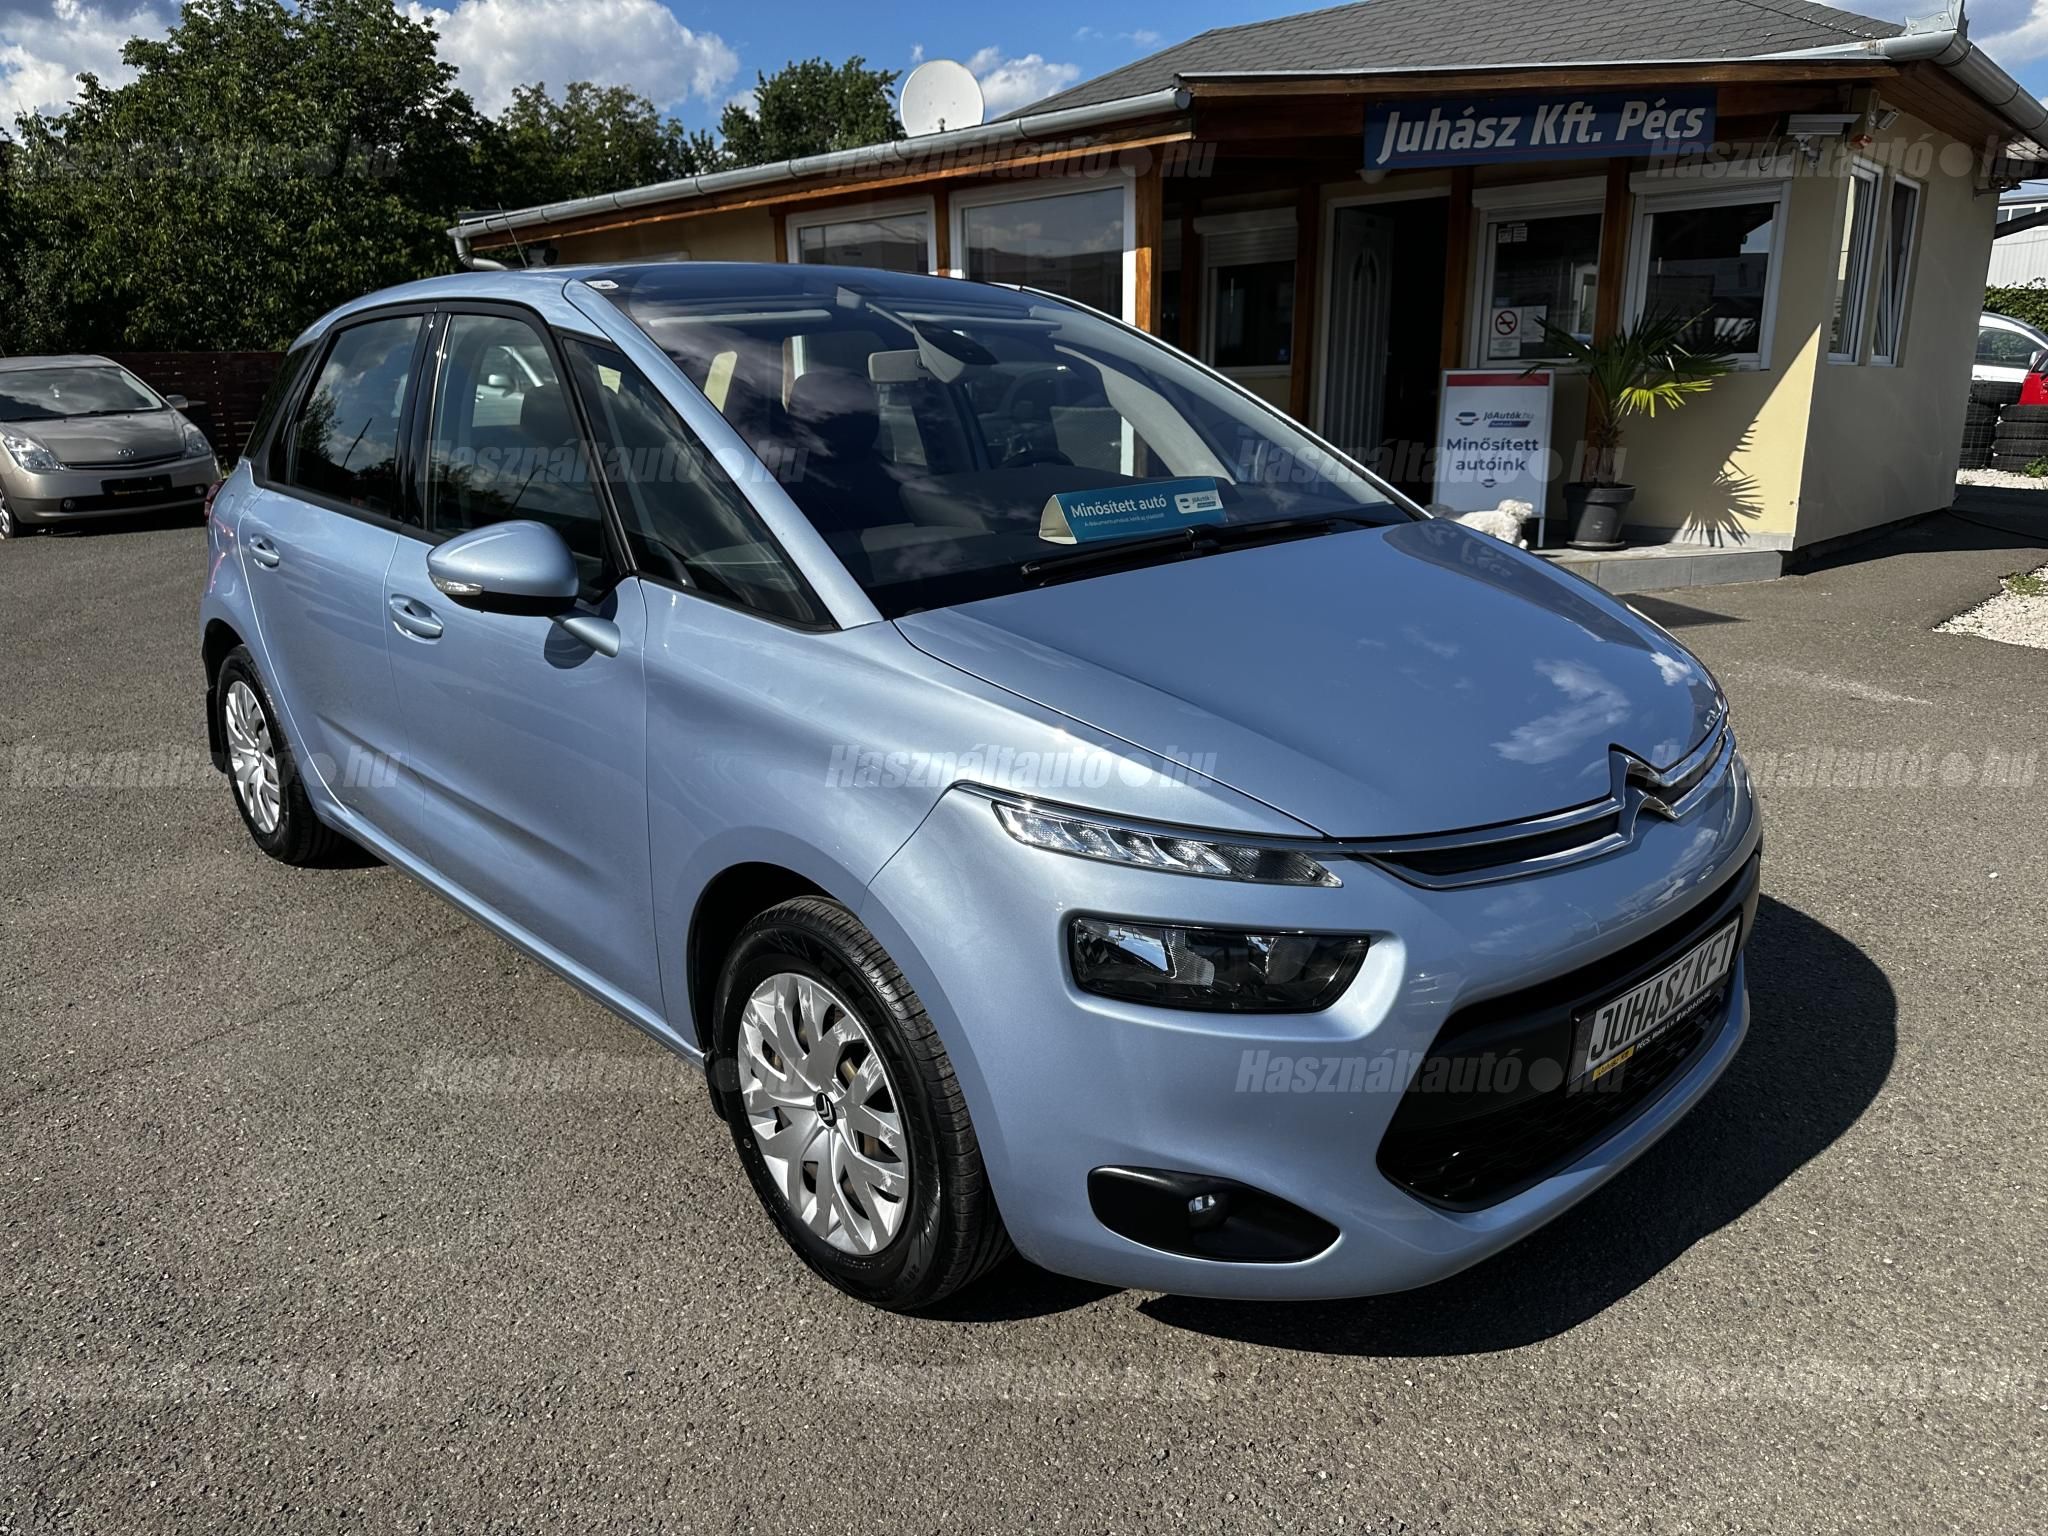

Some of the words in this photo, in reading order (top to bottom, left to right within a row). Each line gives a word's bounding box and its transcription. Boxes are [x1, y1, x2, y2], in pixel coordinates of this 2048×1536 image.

[1375, 106, 1522, 166] Juhász
[1529, 101, 1603, 146] Kft.
[1615, 98, 1706, 142] Pécs
[1446, 437, 1540, 452] Minősített
[1455, 457, 1527, 471] autóink
[1069, 499, 1138, 519] Minősített
[1141, 494, 1168, 510] autó
